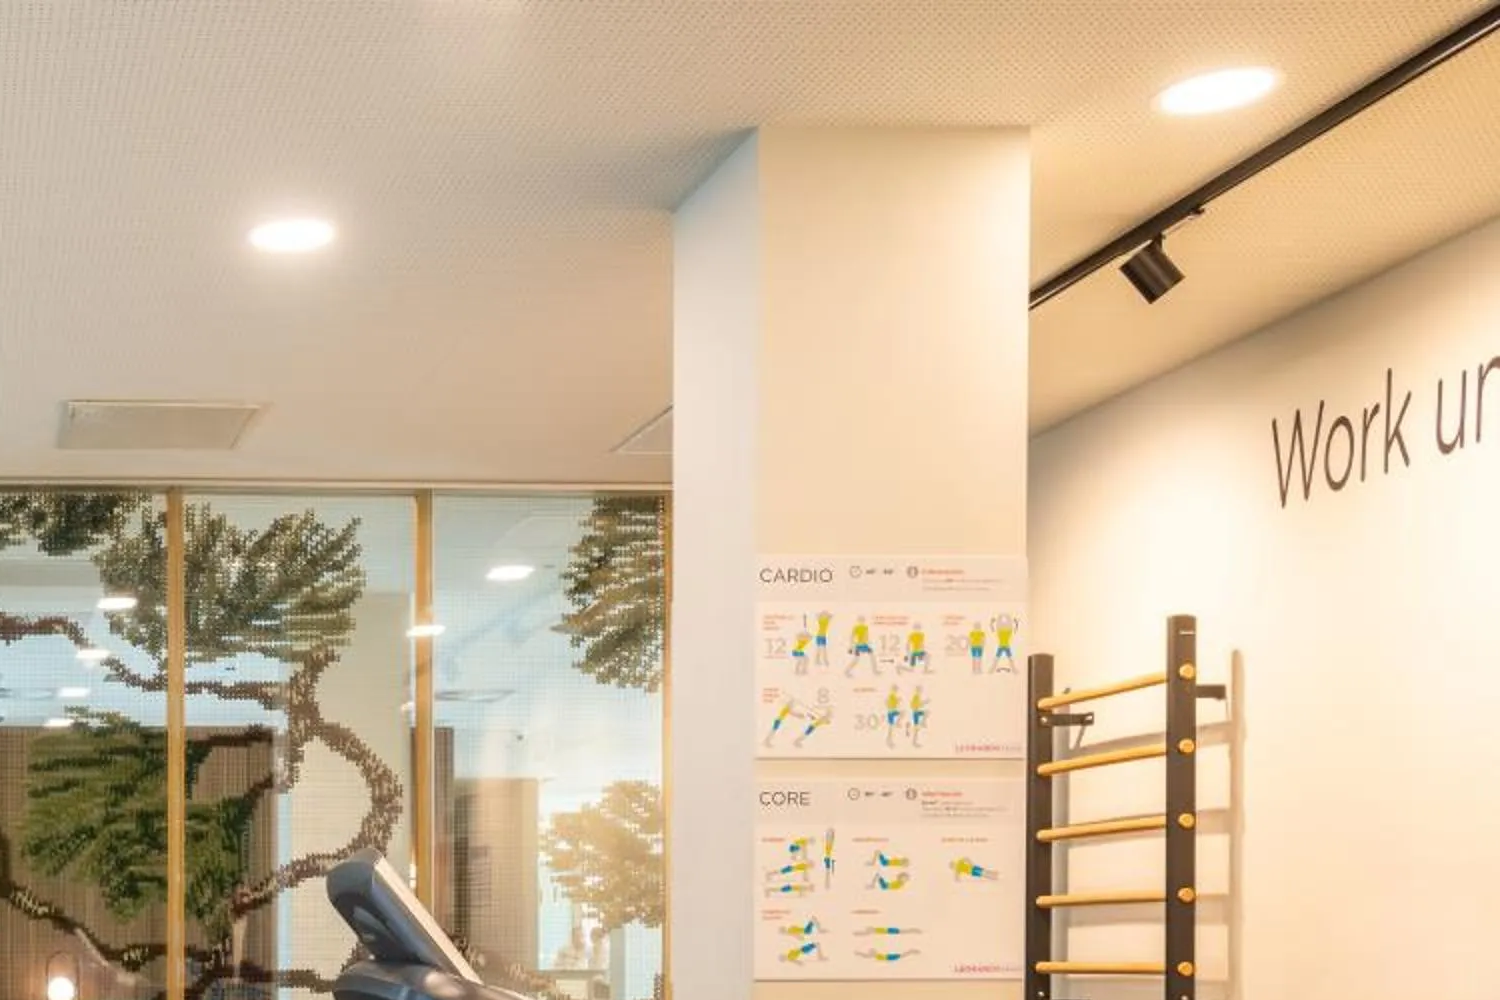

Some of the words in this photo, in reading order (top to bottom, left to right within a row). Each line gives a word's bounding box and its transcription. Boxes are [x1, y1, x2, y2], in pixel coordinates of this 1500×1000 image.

[1271, 368, 1412, 508] Work
[759, 568, 833, 583] CARDIO
[759, 791, 811, 806] CORE
